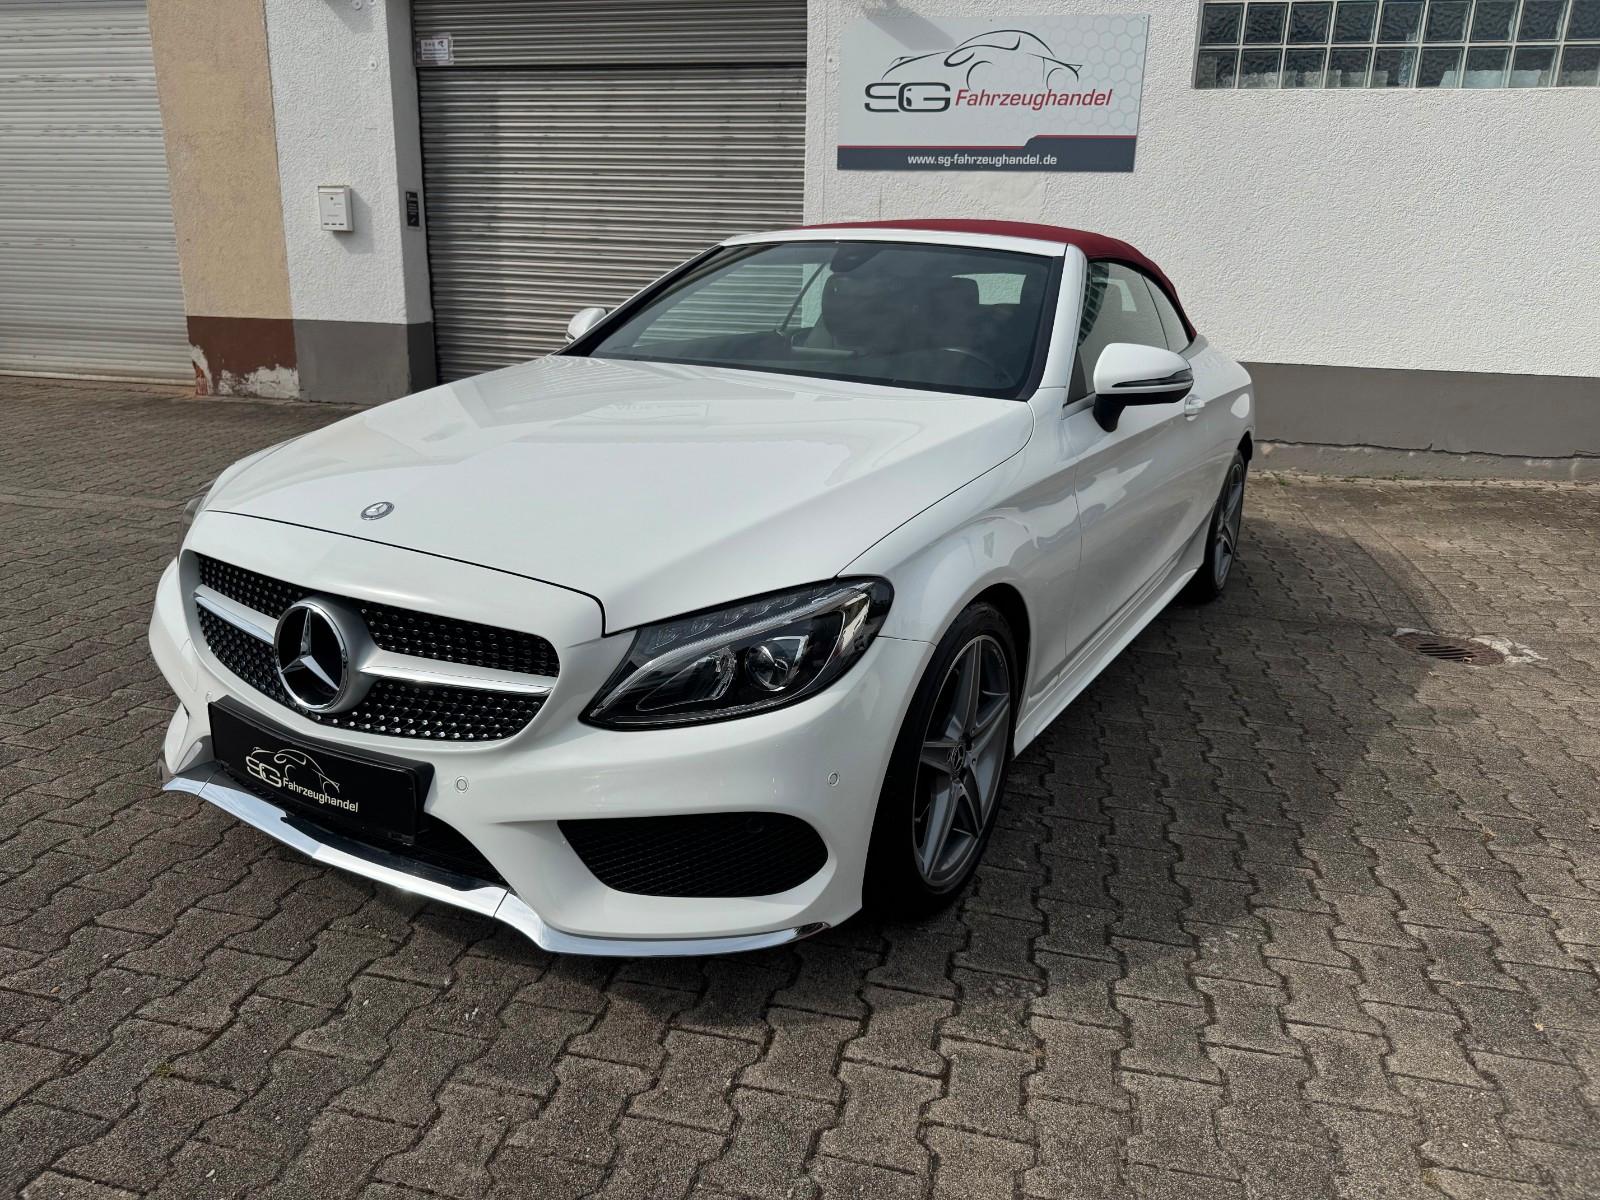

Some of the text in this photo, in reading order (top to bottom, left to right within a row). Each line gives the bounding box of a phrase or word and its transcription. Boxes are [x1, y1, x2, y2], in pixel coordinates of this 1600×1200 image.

[864, 82, 1113, 113] SG Fahrzeughandel
[907, 154, 1057, 167] www.sg-fahrzeughandel.de
[246, 756, 359, 812] SG Fahrzeughandel
